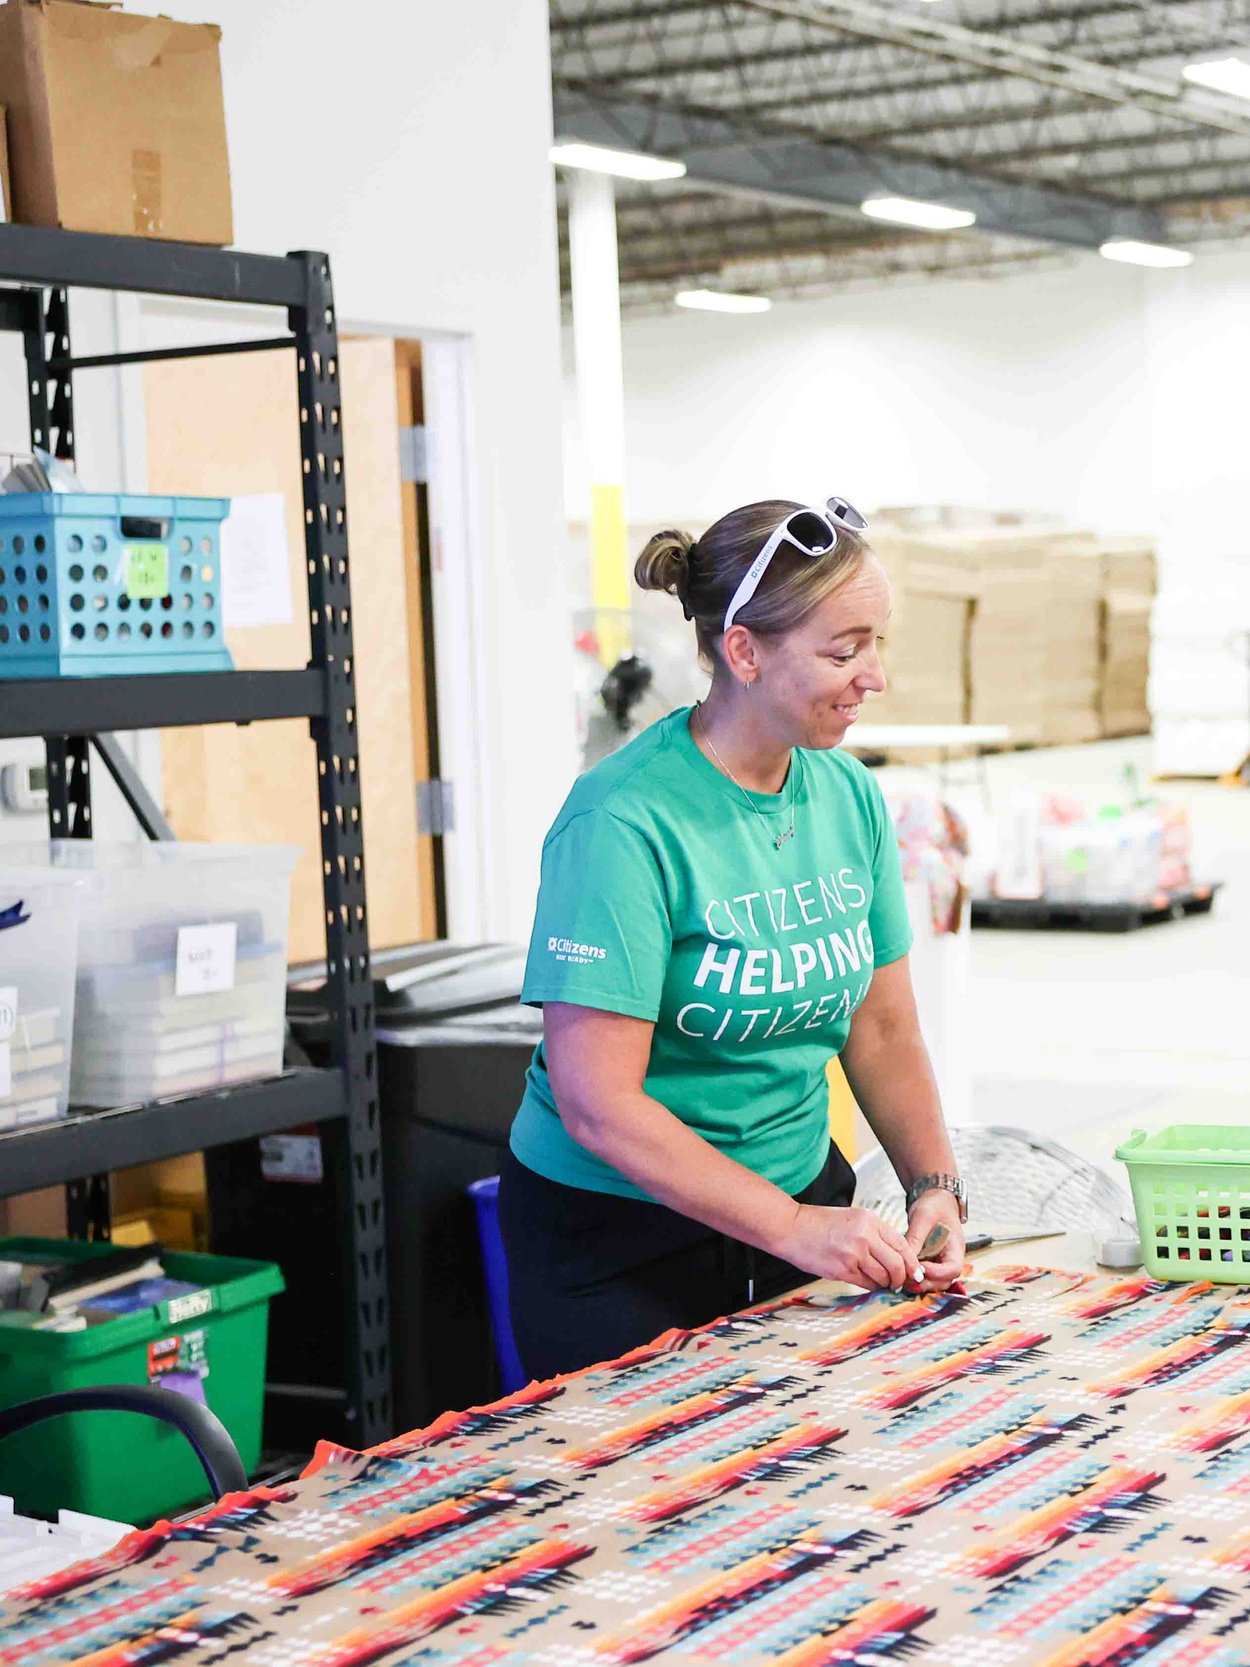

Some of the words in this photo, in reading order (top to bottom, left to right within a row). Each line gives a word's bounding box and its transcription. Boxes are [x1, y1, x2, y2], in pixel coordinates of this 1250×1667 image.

[705, 867, 867, 940] CITIZENS
[557, 938, 607, 959] Citizens
[692, 919, 875, 996] HELPING
[676, 983, 870, 1044] CITIZEN
